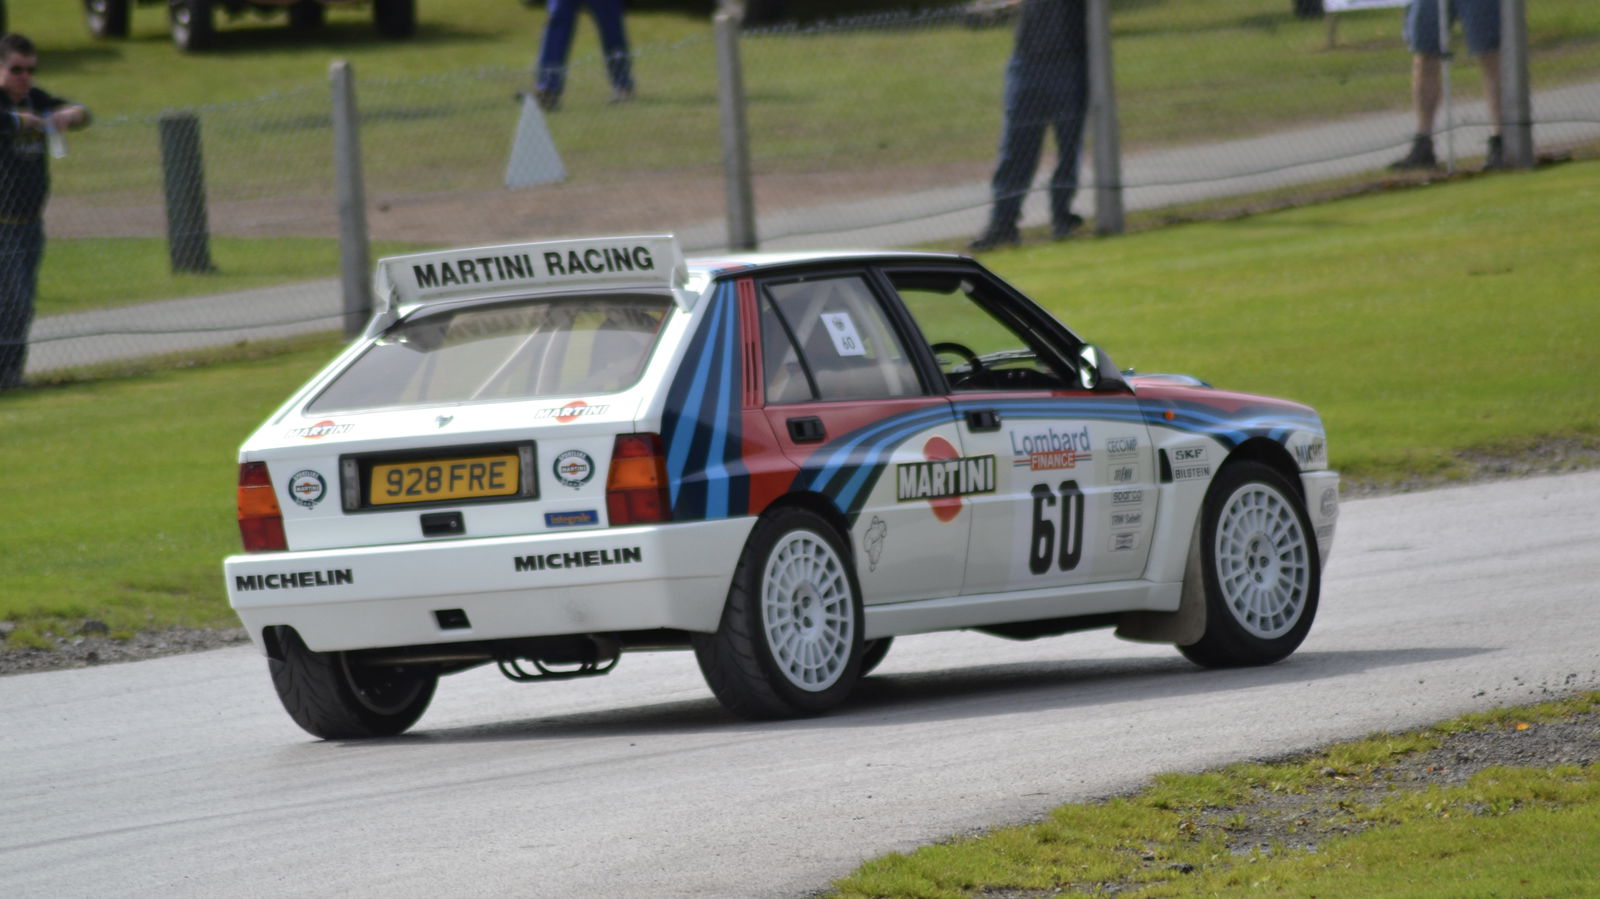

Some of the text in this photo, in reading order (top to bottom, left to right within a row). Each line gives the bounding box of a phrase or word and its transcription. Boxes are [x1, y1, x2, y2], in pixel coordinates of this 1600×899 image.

[413, 246, 654, 288] MARTINI RACING
[535, 405, 609, 420] MARTINI
[285, 423, 354, 439] MARTINI
[1010, 427, 1091, 456] Lombard
[1031, 453, 1074, 469] FINANCE
[1175, 448, 1203, 461] SKF
[386, 461, 507, 496] 928 FRE
[900, 457, 993, 500] MARTINI
[1175, 466, 1210, 480] BILSTEIN
[1029, 480, 1085, 576] 60
[514, 547, 643, 572] MICHELIN
[235, 568, 354, 592] MICHELIN
